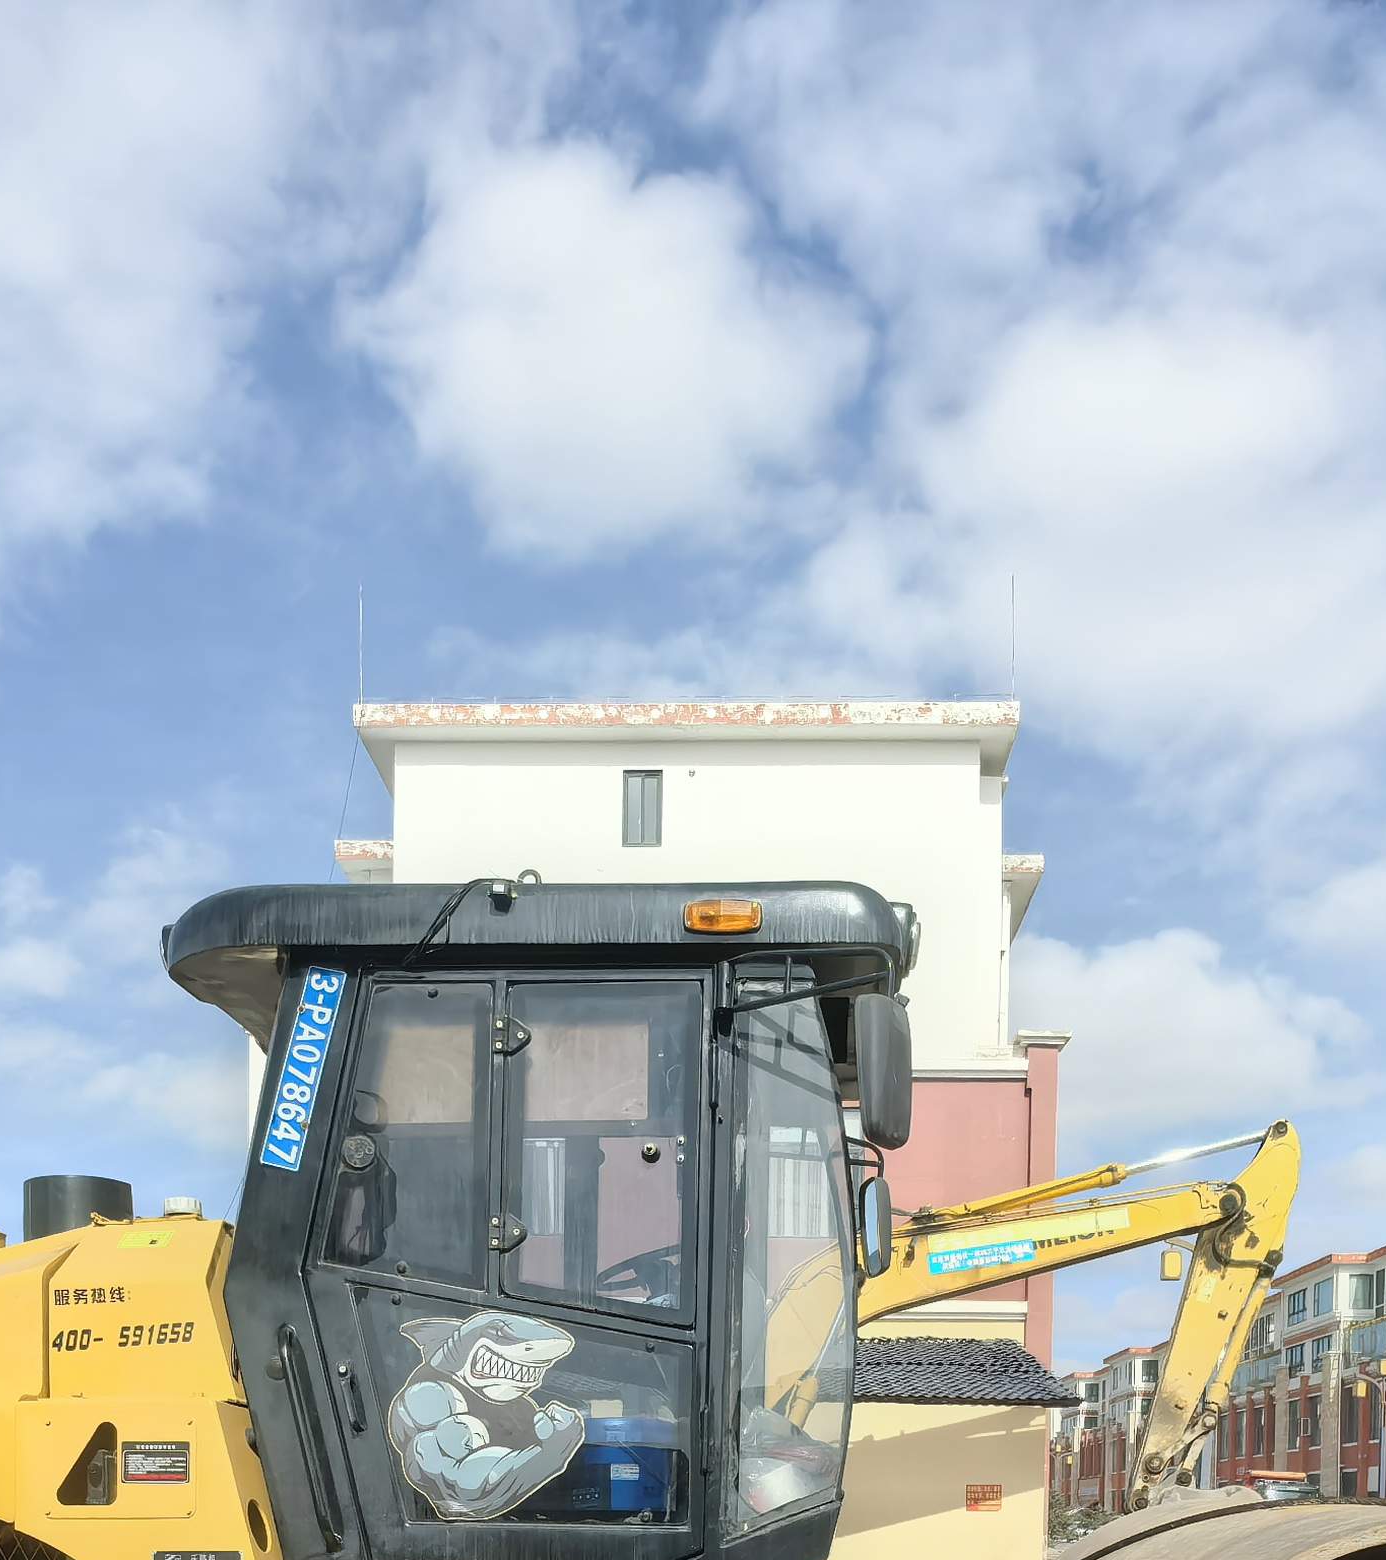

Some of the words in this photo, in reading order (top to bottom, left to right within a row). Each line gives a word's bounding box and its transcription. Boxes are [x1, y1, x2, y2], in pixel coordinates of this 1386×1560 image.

[267, 972, 340, 1165] 3-PA078647
[51, 1329, 104, 1352] 400-
[117, 1321, 195, 1348] 591658
